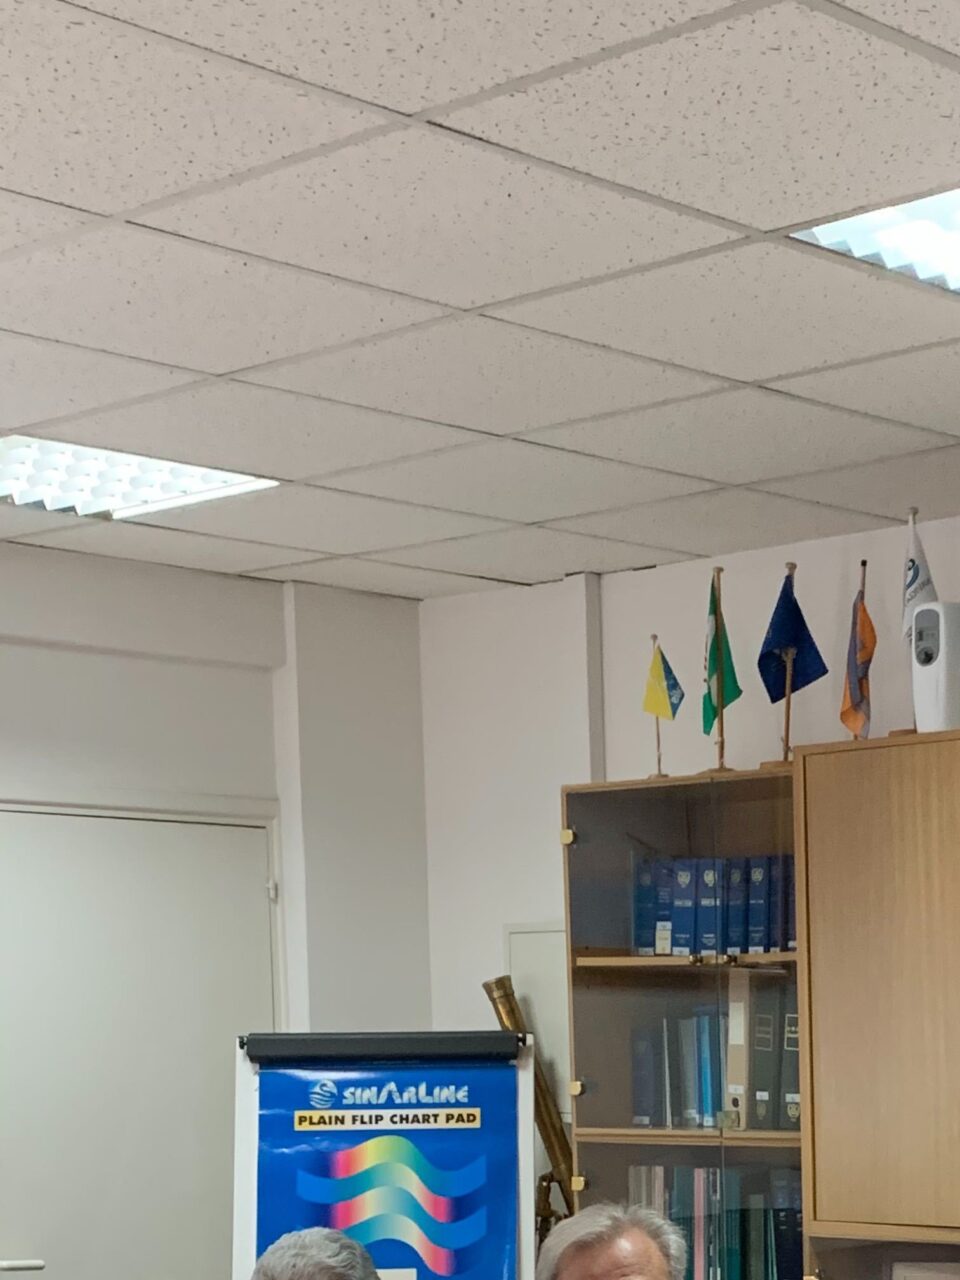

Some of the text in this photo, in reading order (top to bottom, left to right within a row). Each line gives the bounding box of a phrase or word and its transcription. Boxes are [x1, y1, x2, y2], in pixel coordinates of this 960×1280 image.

[298, 1112, 477, 1126] PLAIN FLIP CHART PAD
